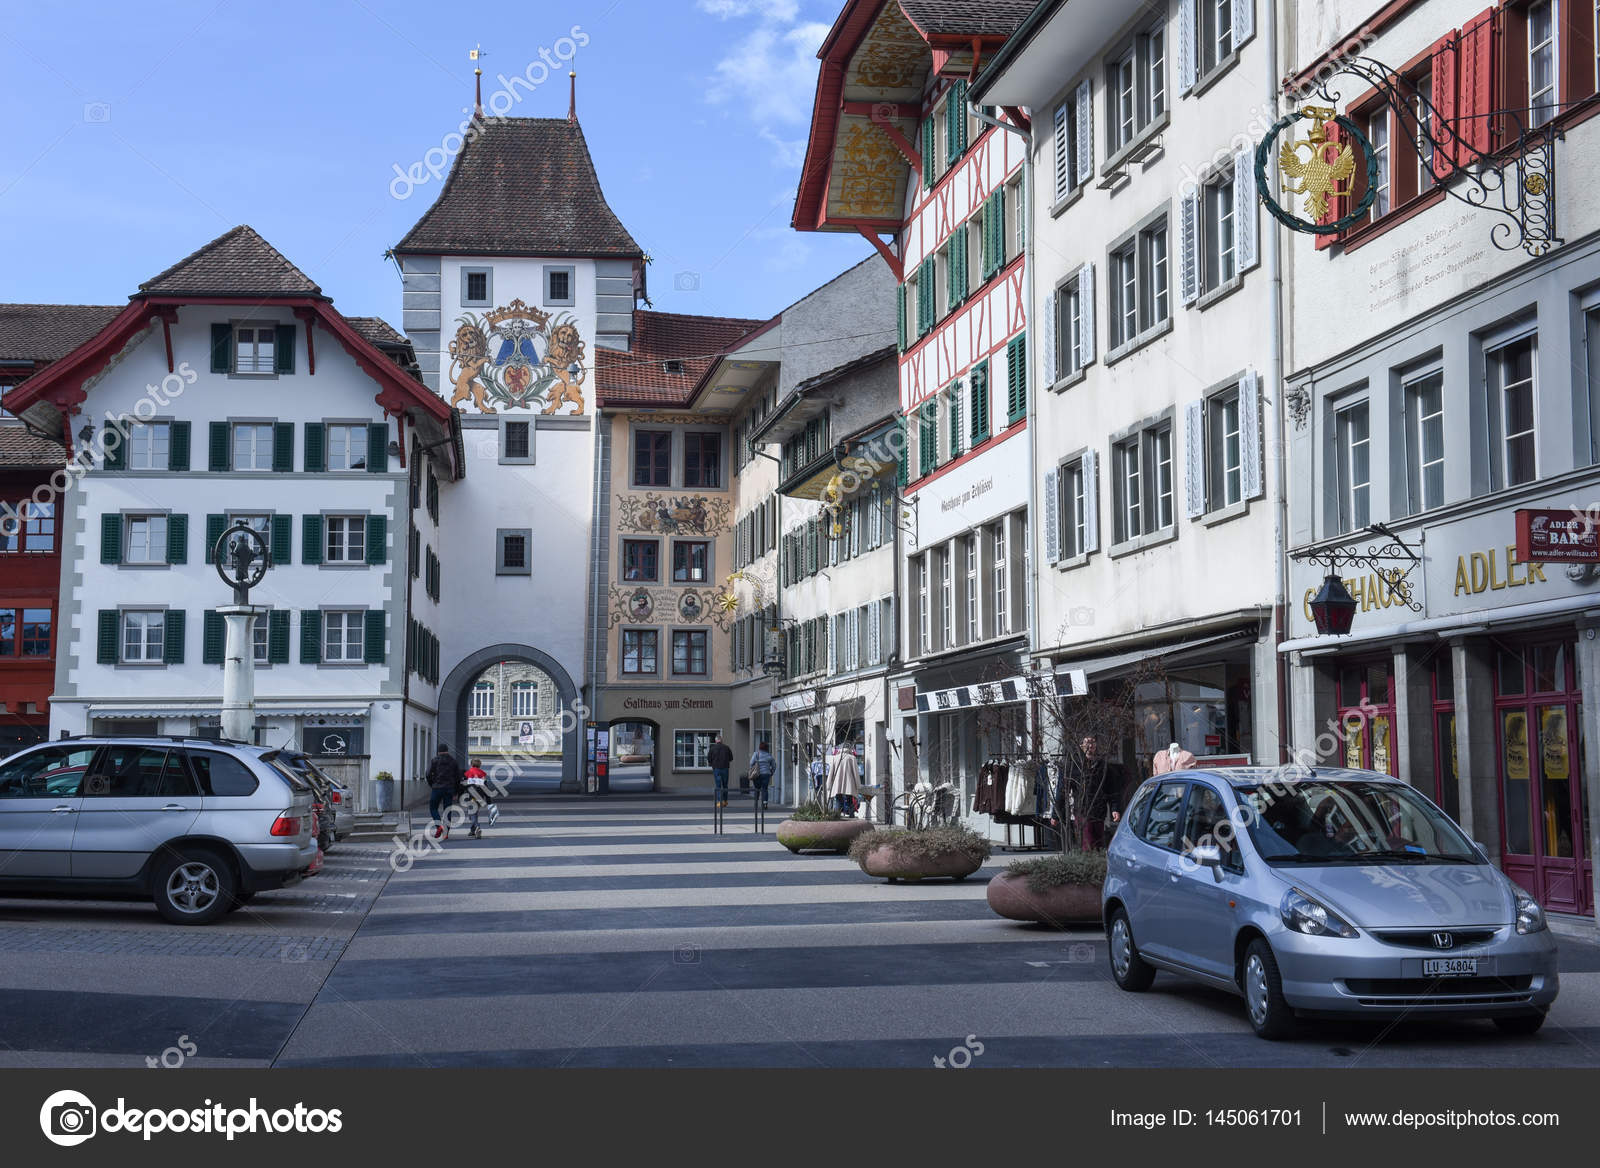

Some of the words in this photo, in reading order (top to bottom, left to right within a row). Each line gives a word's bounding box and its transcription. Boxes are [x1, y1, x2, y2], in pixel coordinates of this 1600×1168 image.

[1549, 521, 1579, 529] ADLER
[1549, 532, 1580, 545] BAR
[664, 699, 680, 710] zum
[681, 697, 713, 709] Sternen
